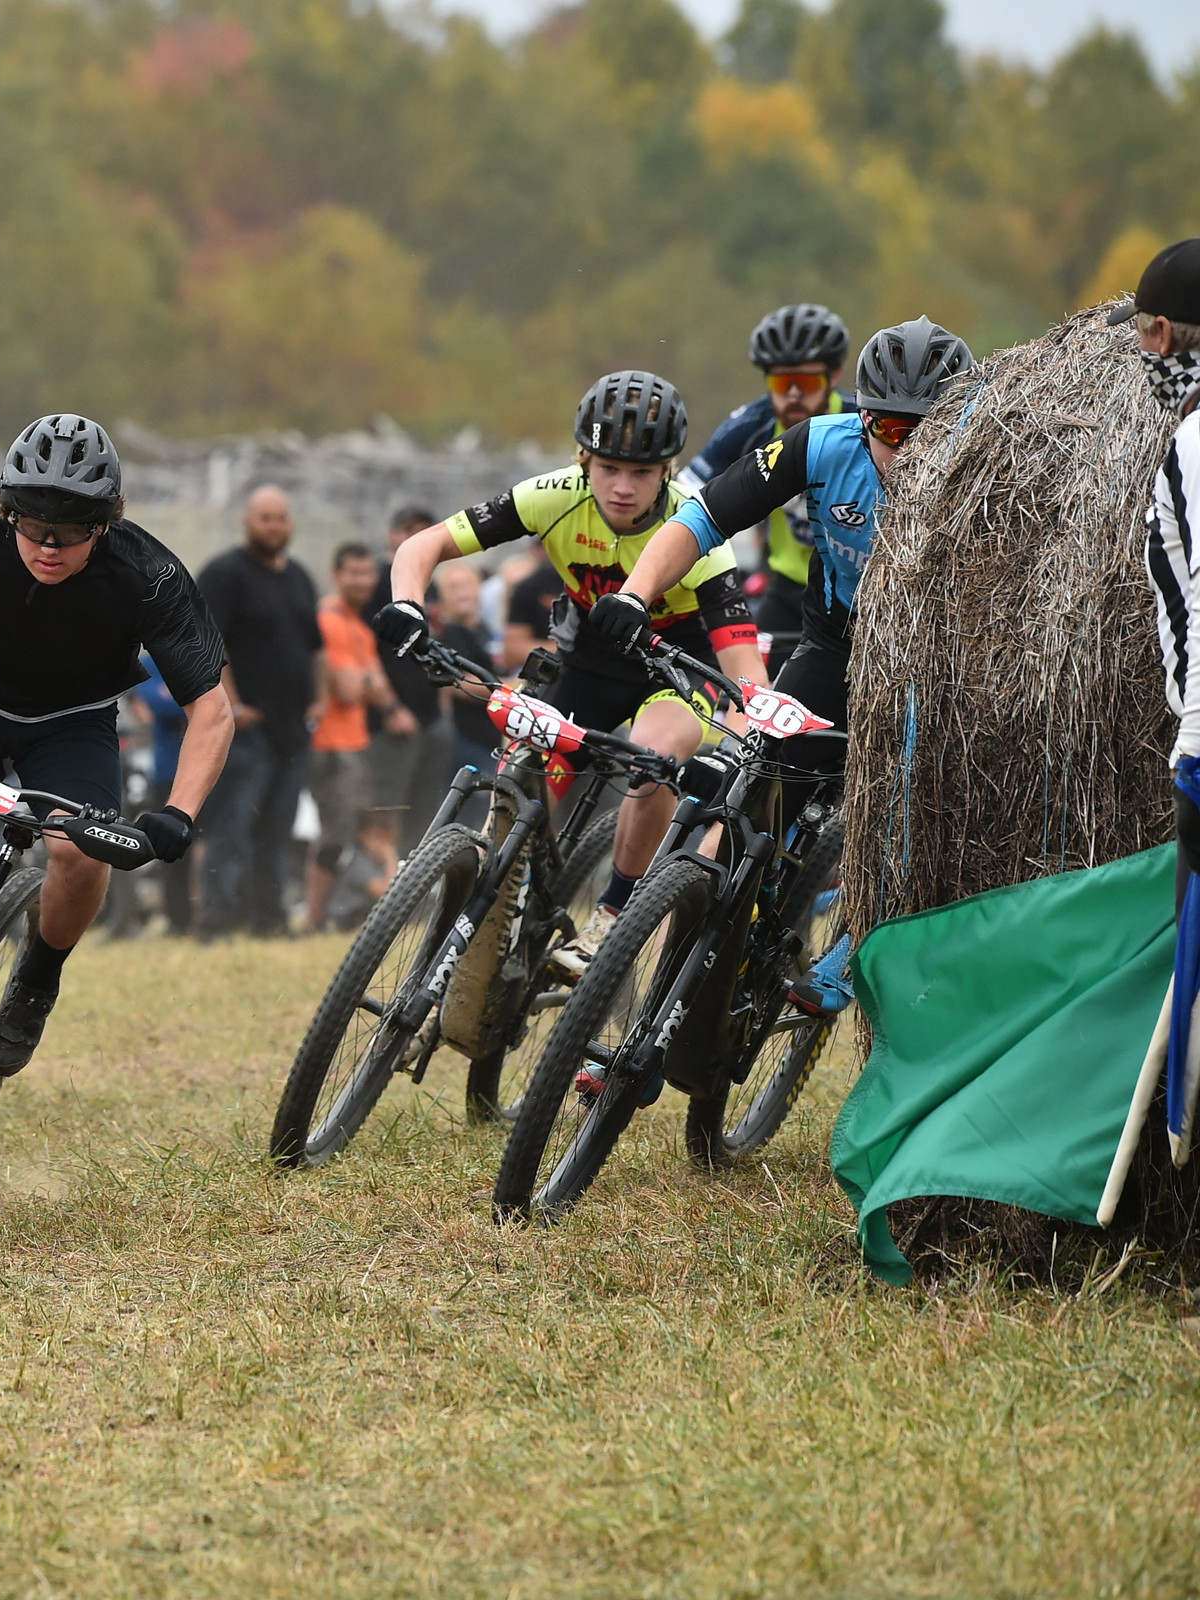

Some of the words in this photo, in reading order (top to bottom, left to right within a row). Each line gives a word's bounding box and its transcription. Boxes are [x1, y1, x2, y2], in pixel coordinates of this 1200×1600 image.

[536, 476, 572, 490] LIVE
[745, 694, 806, 734] 96
[85, 828, 139, 849] ACERBIS
[427, 945, 462, 996] FOX
[654, 1000, 689, 1050] FOX
